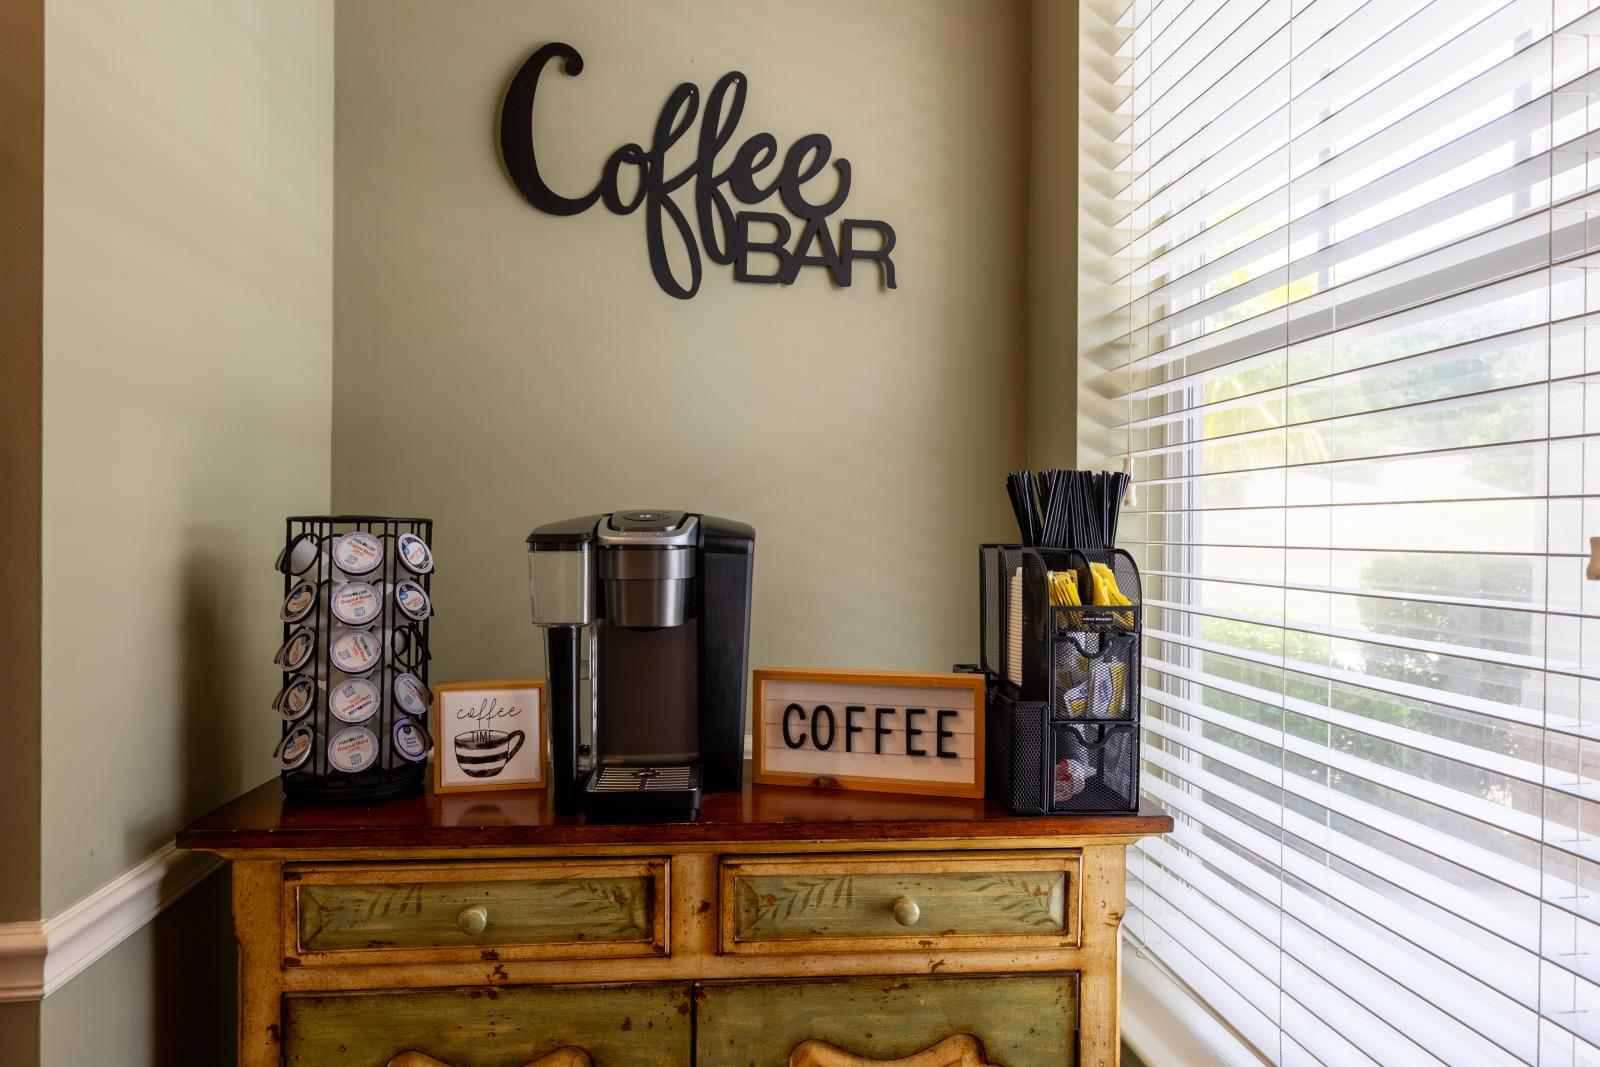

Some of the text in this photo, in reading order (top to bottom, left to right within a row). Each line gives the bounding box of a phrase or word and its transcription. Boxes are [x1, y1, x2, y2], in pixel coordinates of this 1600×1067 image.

[501, 42, 852, 300] Coffee
[734, 211, 897, 290] BAR
[456, 698, 522, 729] coffee
[471, 731, 493, 743] TIME
[782, 703, 957, 758] COFFEE
